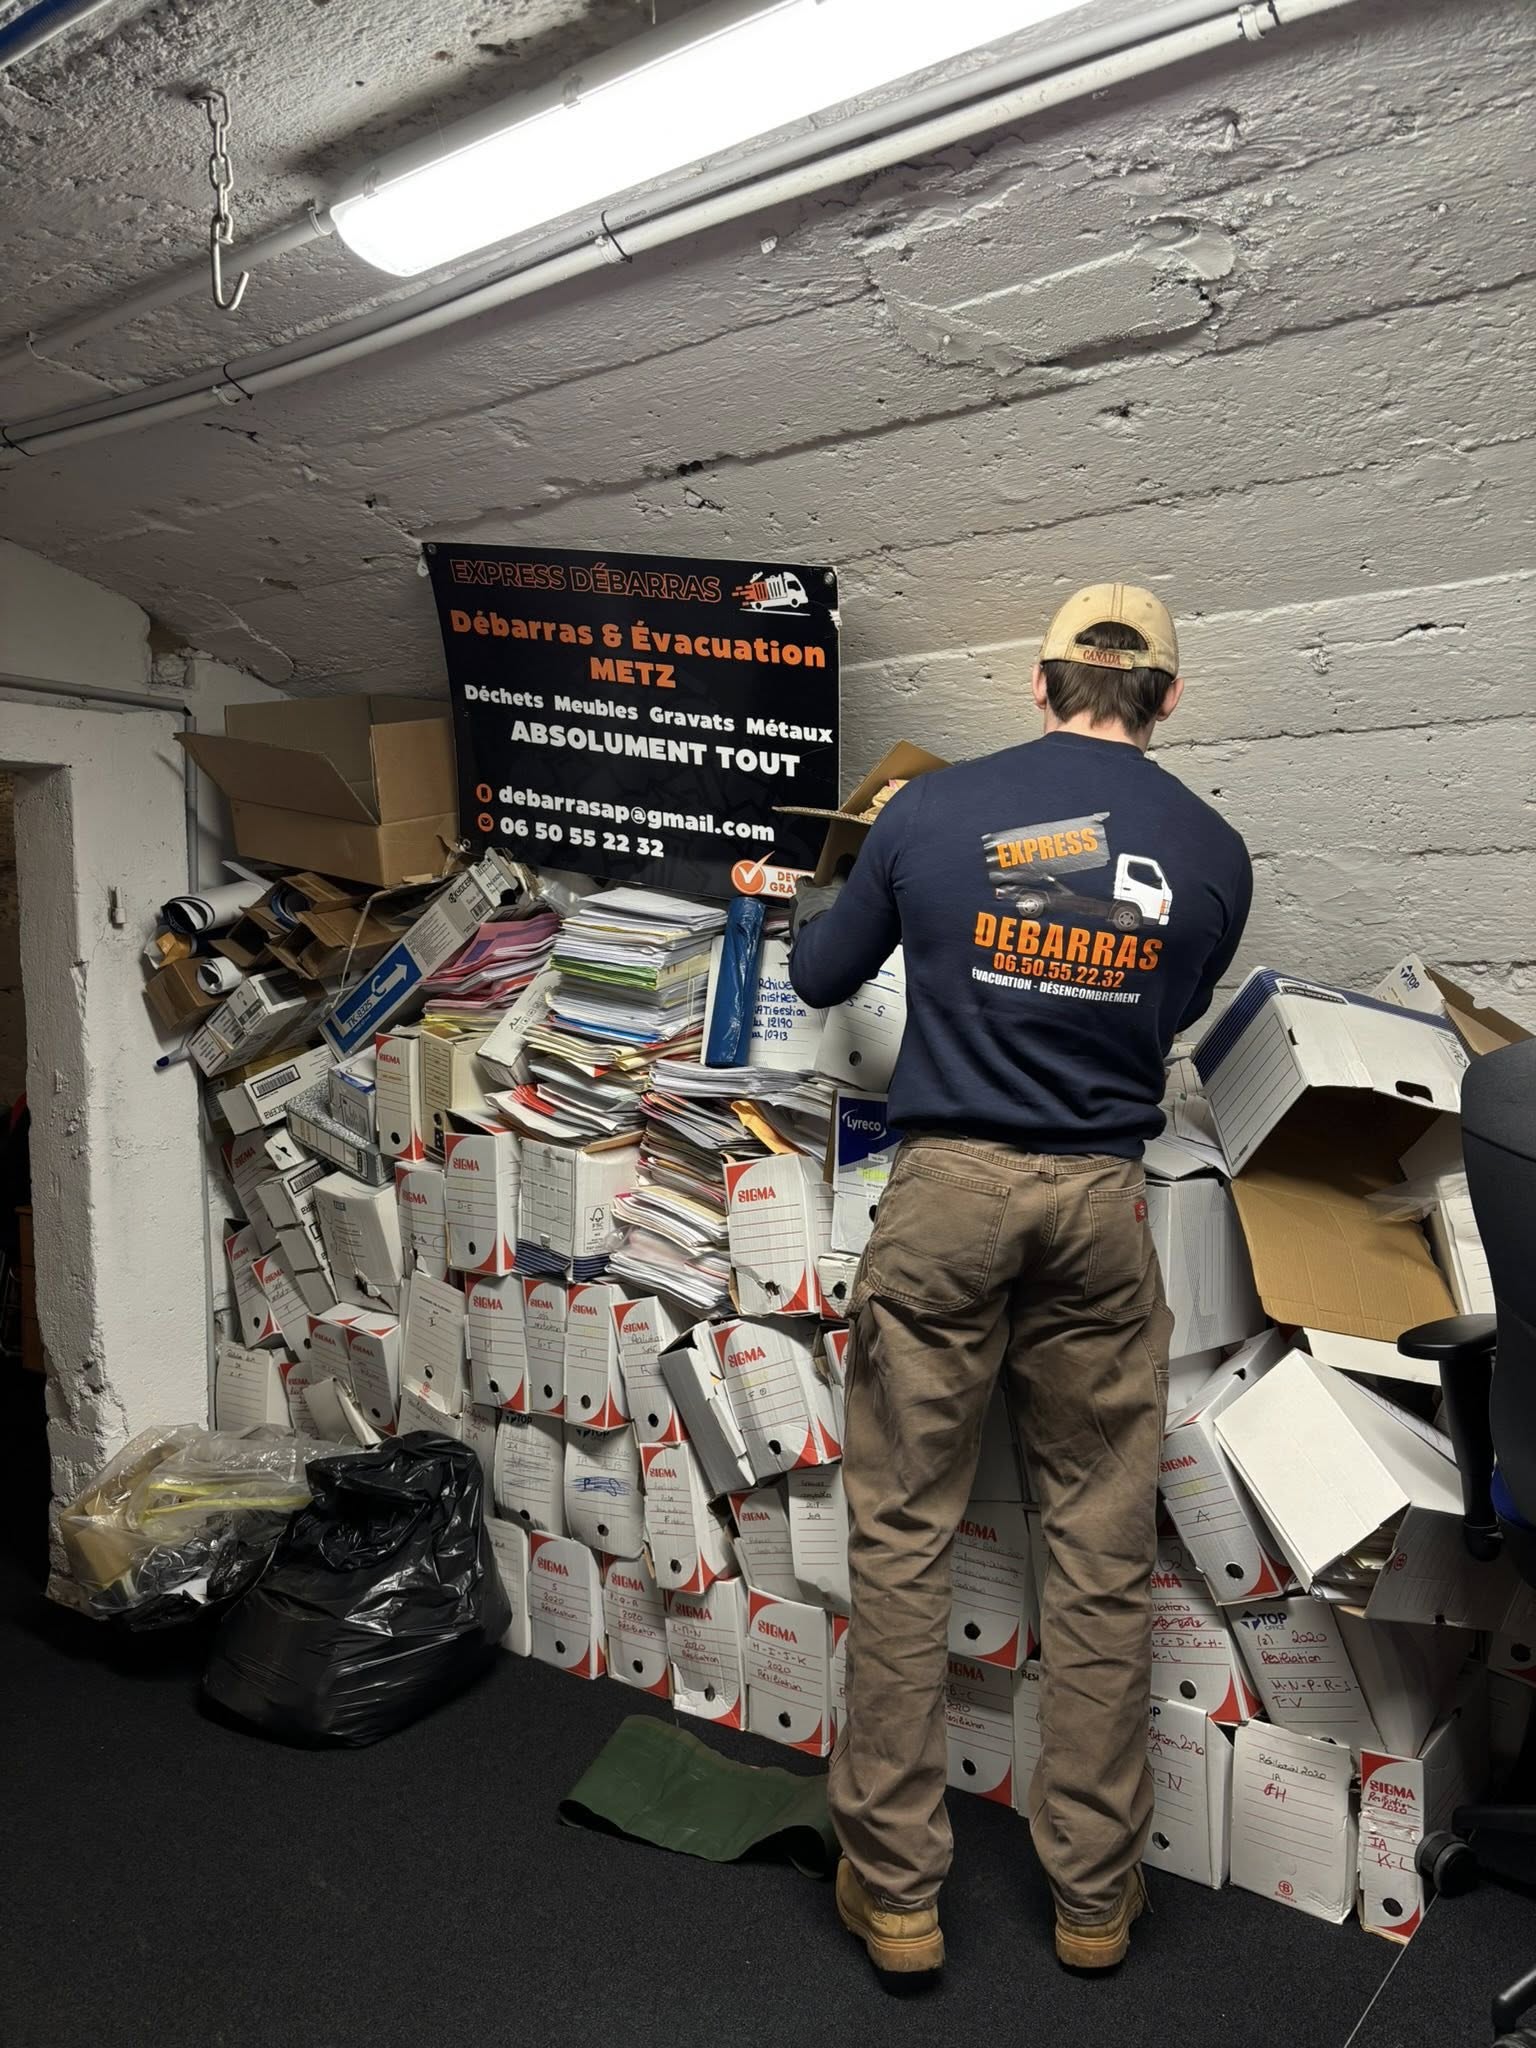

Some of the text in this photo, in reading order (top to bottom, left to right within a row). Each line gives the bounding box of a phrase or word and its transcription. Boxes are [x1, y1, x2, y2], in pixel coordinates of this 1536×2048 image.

[449, 558, 721, 603] EXPRESS DÉBARRAS
[449, 609, 826, 668] Débarras & Évacuation
[1083, 649, 1121, 666] CANADA
[589, 657, 677, 688] METZ
[464, 684, 833, 744] Déchets Meubles Gravats Métaux
[510, 720, 800, 777] ABSOLUMENT TOUT
[498, 784, 775, 842] debarrasap@gmail.com
[500, 816, 664, 858] 06 50 55 22 32
[996, 828, 1099, 869] EXPRESS
[973, 911, 1164, 971] DEBARRAS
[993, 953, 1125, 989] 06.50.55.22.32
[971, 967, 1032, 990] ÉVACUATION
[1039, 979, 1141, 1004] DÉSENCOMBREMENT
[1407, 972, 1420, 989] TOP
[380, 1053, 400, 1065] SIGMA
[847, 1115, 881, 1132] Lyreco
[453, 1158, 479, 1171] SIGMA
[402, 1189, 427, 1205] SIGMA
[738, 1186, 776, 1203] SIGMA
[264, 1267, 285, 1284] SIGMA
[473, 1296, 503, 1311] SIGMA
[530, 1299, 553, 1310] SIGMA
[572, 1304, 598, 1316] SIGMA
[622, 1321, 650, 1334] SIGMA
[727, 1346, 766, 1368] SIGMA
[649, 1468, 677, 1478] SIGMA
[1160, 1455, 1197, 1473] SIGMA
[742, 1511, 770, 1522] SIGMA
[537, 1556, 569, 1577] SIGMA
[611, 1572, 645, 1593] SIGMA
[675, 1603, 712, 1621] SIGMA
[1257, 1612, 1287, 1625] TOP
[757, 1619, 798, 1644] SIGMA
[1291, 1630, 1328, 1644] 2020
[767, 1661, 791, 1674] 2020
[948, 1660, 984, 1682] IGMA
[1369, 1780, 1415, 1801] SIGMA
[1368, 1836, 1387, 1851] IA
